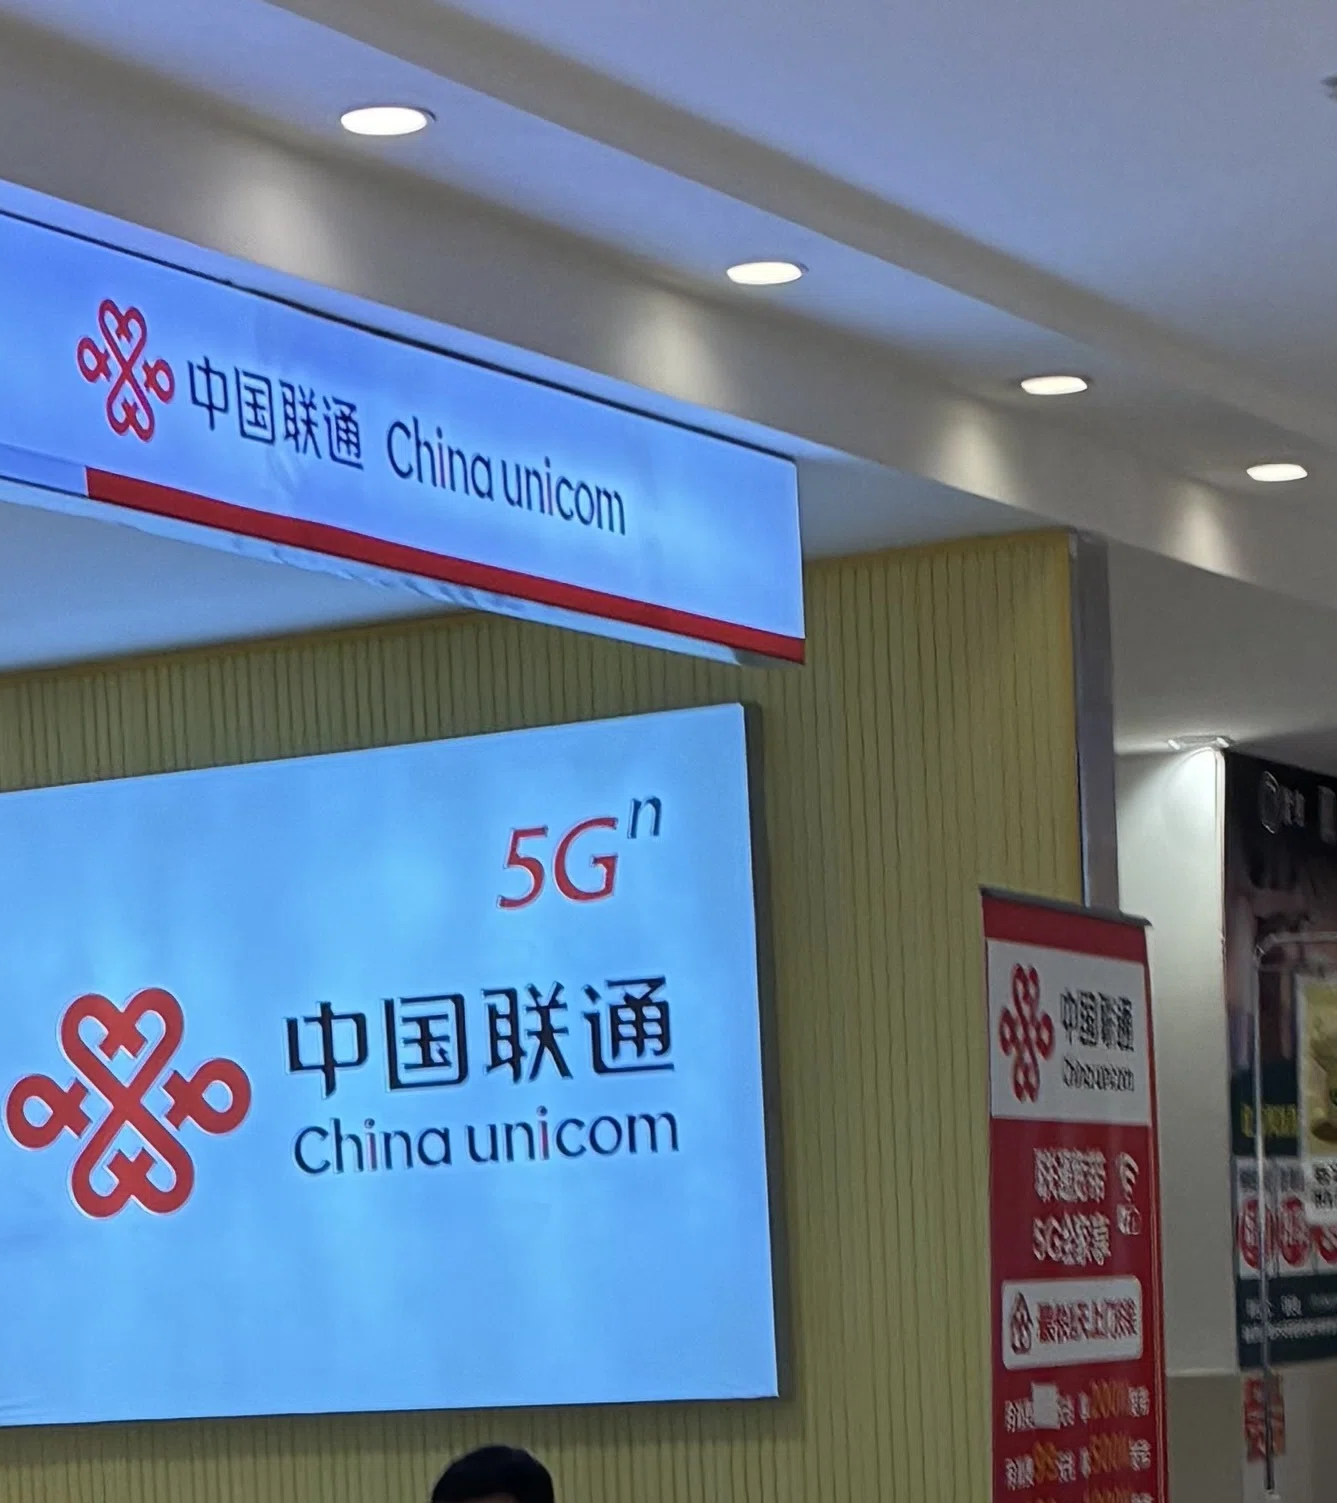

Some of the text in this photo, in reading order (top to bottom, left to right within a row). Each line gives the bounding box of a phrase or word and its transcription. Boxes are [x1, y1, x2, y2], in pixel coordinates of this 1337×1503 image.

[187, 355, 364, 470] 中国联通
[282, 974, 676, 1100] 中国联通
[1060, 987, 1135, 1053] 中国联通
